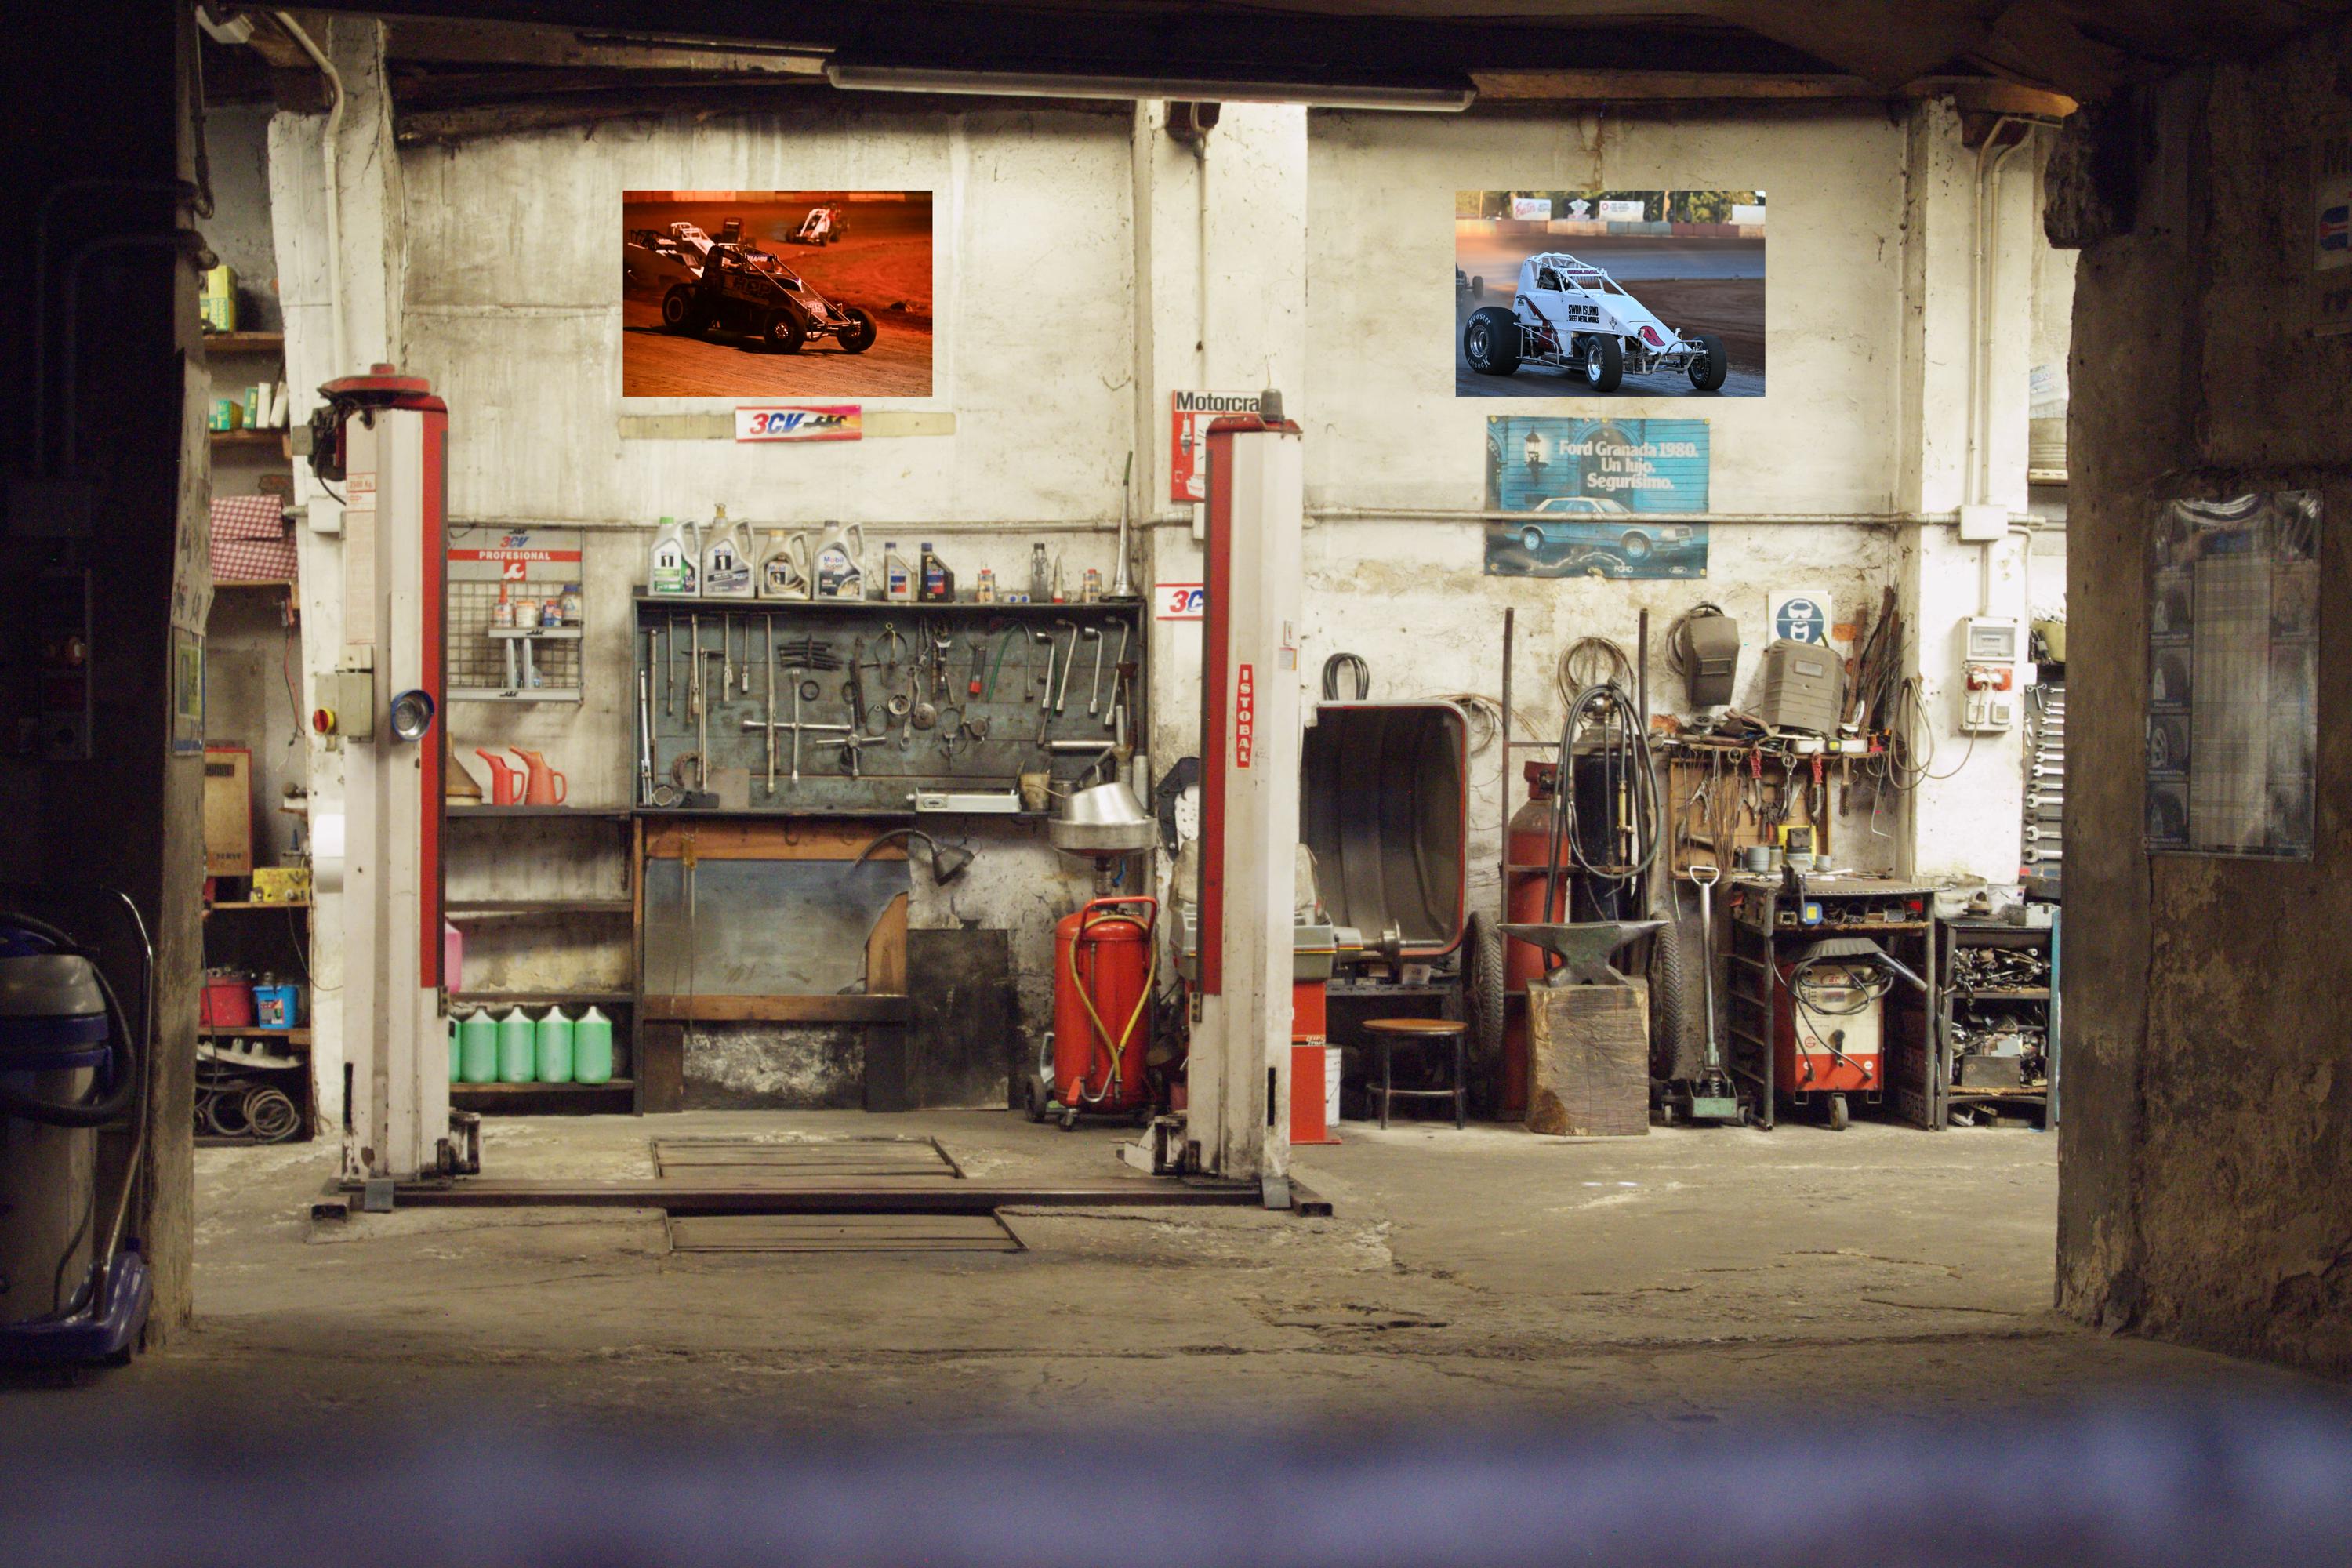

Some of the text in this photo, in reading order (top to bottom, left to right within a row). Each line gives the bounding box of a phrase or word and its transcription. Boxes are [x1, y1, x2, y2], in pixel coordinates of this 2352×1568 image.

[1568, 304, 1599, 316] SWAN ISLAND
[1176, 391, 1261, 412] Motorcra
[749, 412, 806, 434] 3CV
[1559, 440, 1700, 458] Ford Granada 1980.
[1601, 457, 1656, 476] Un lujo.
[1587, 472, 1675, 492] Segurísimo.
[500, 535, 530, 548] 3CV
[479, 551, 551, 560] PROFESIONAL
[1238, 670, 1251, 762] ISTOBAL
